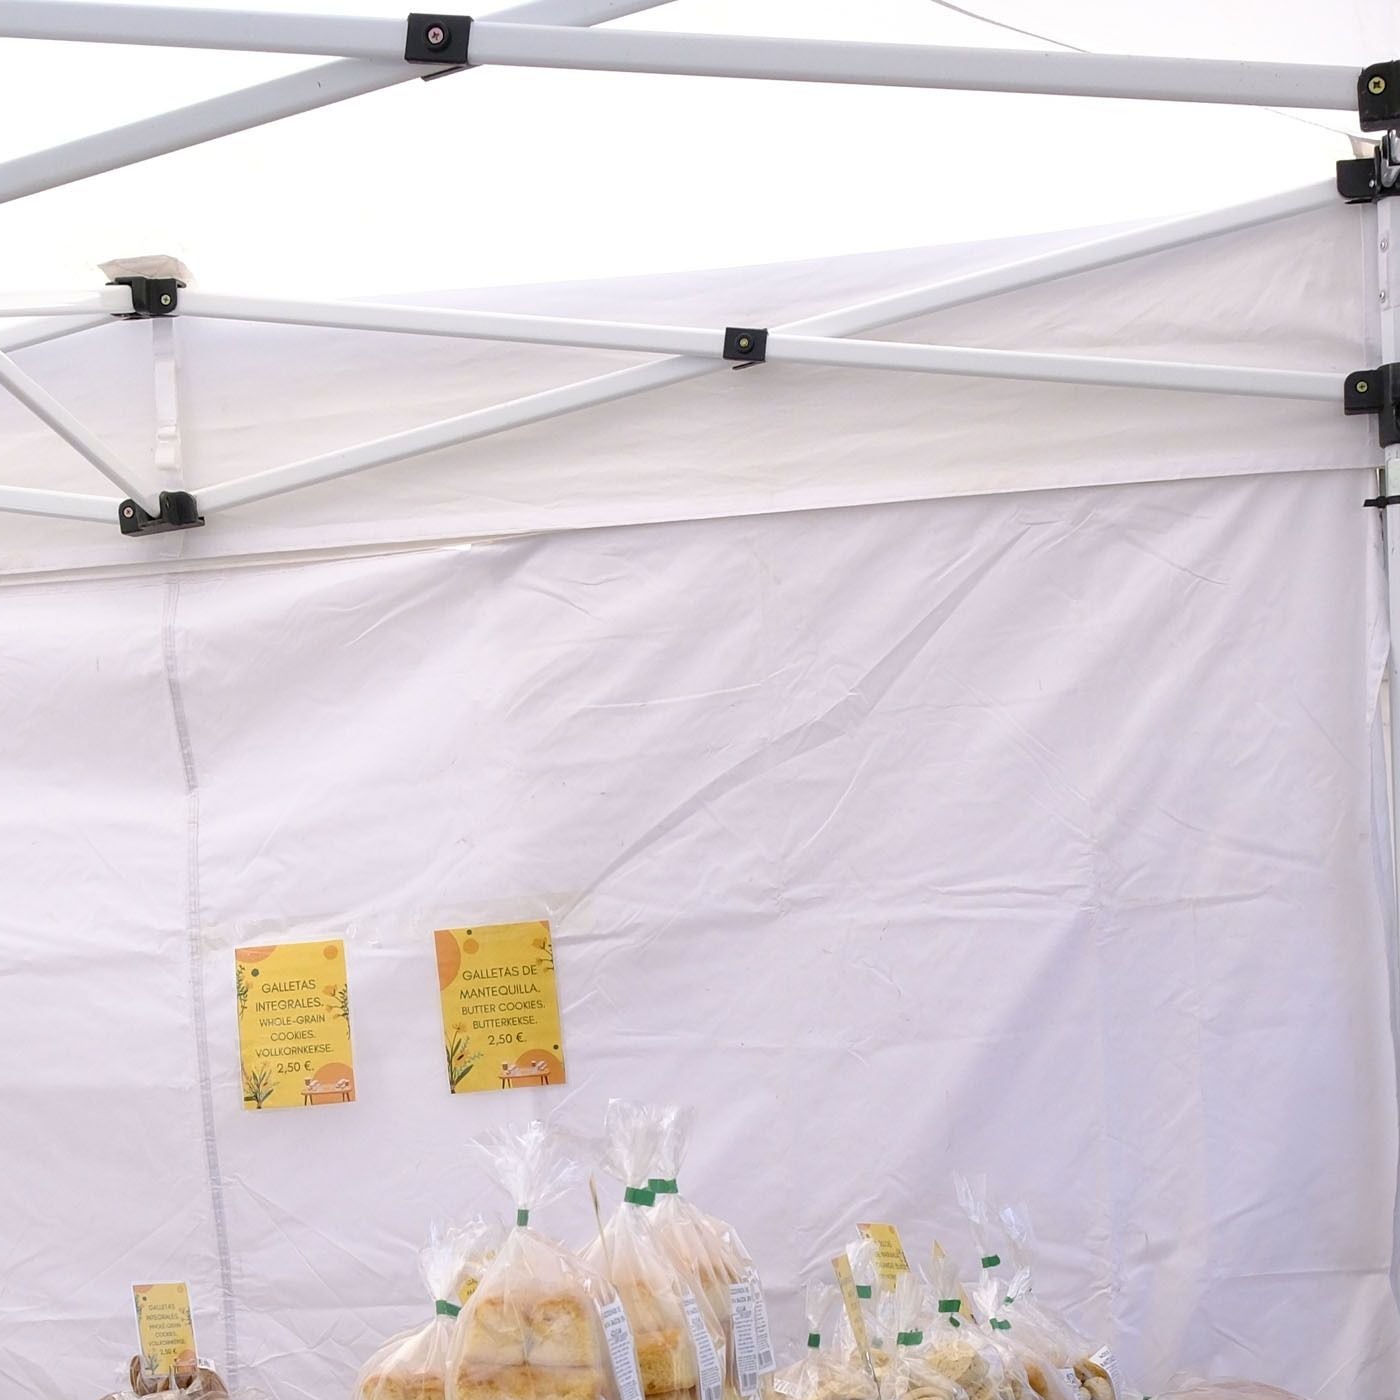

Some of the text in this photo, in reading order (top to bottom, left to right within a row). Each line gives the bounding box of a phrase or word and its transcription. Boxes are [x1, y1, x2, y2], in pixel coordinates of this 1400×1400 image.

[462, 964, 537, 981] GALLETAS DE
[261, 979, 316, 994] GALLETAS
[459, 985, 541, 999] MANTEQUILLA.
[255, 997, 324, 1012] INTEGRALES.
[462, 1000, 546, 1015] BUTTER COOKIES.
[259, 1015, 326, 1028] WHOLE-GRAIN
[472, 1015, 538, 1030] BUTTERKEKSE.
[487, 1033, 513, 1046] 2,50
[276, 1062, 301, 1075] 2,50
